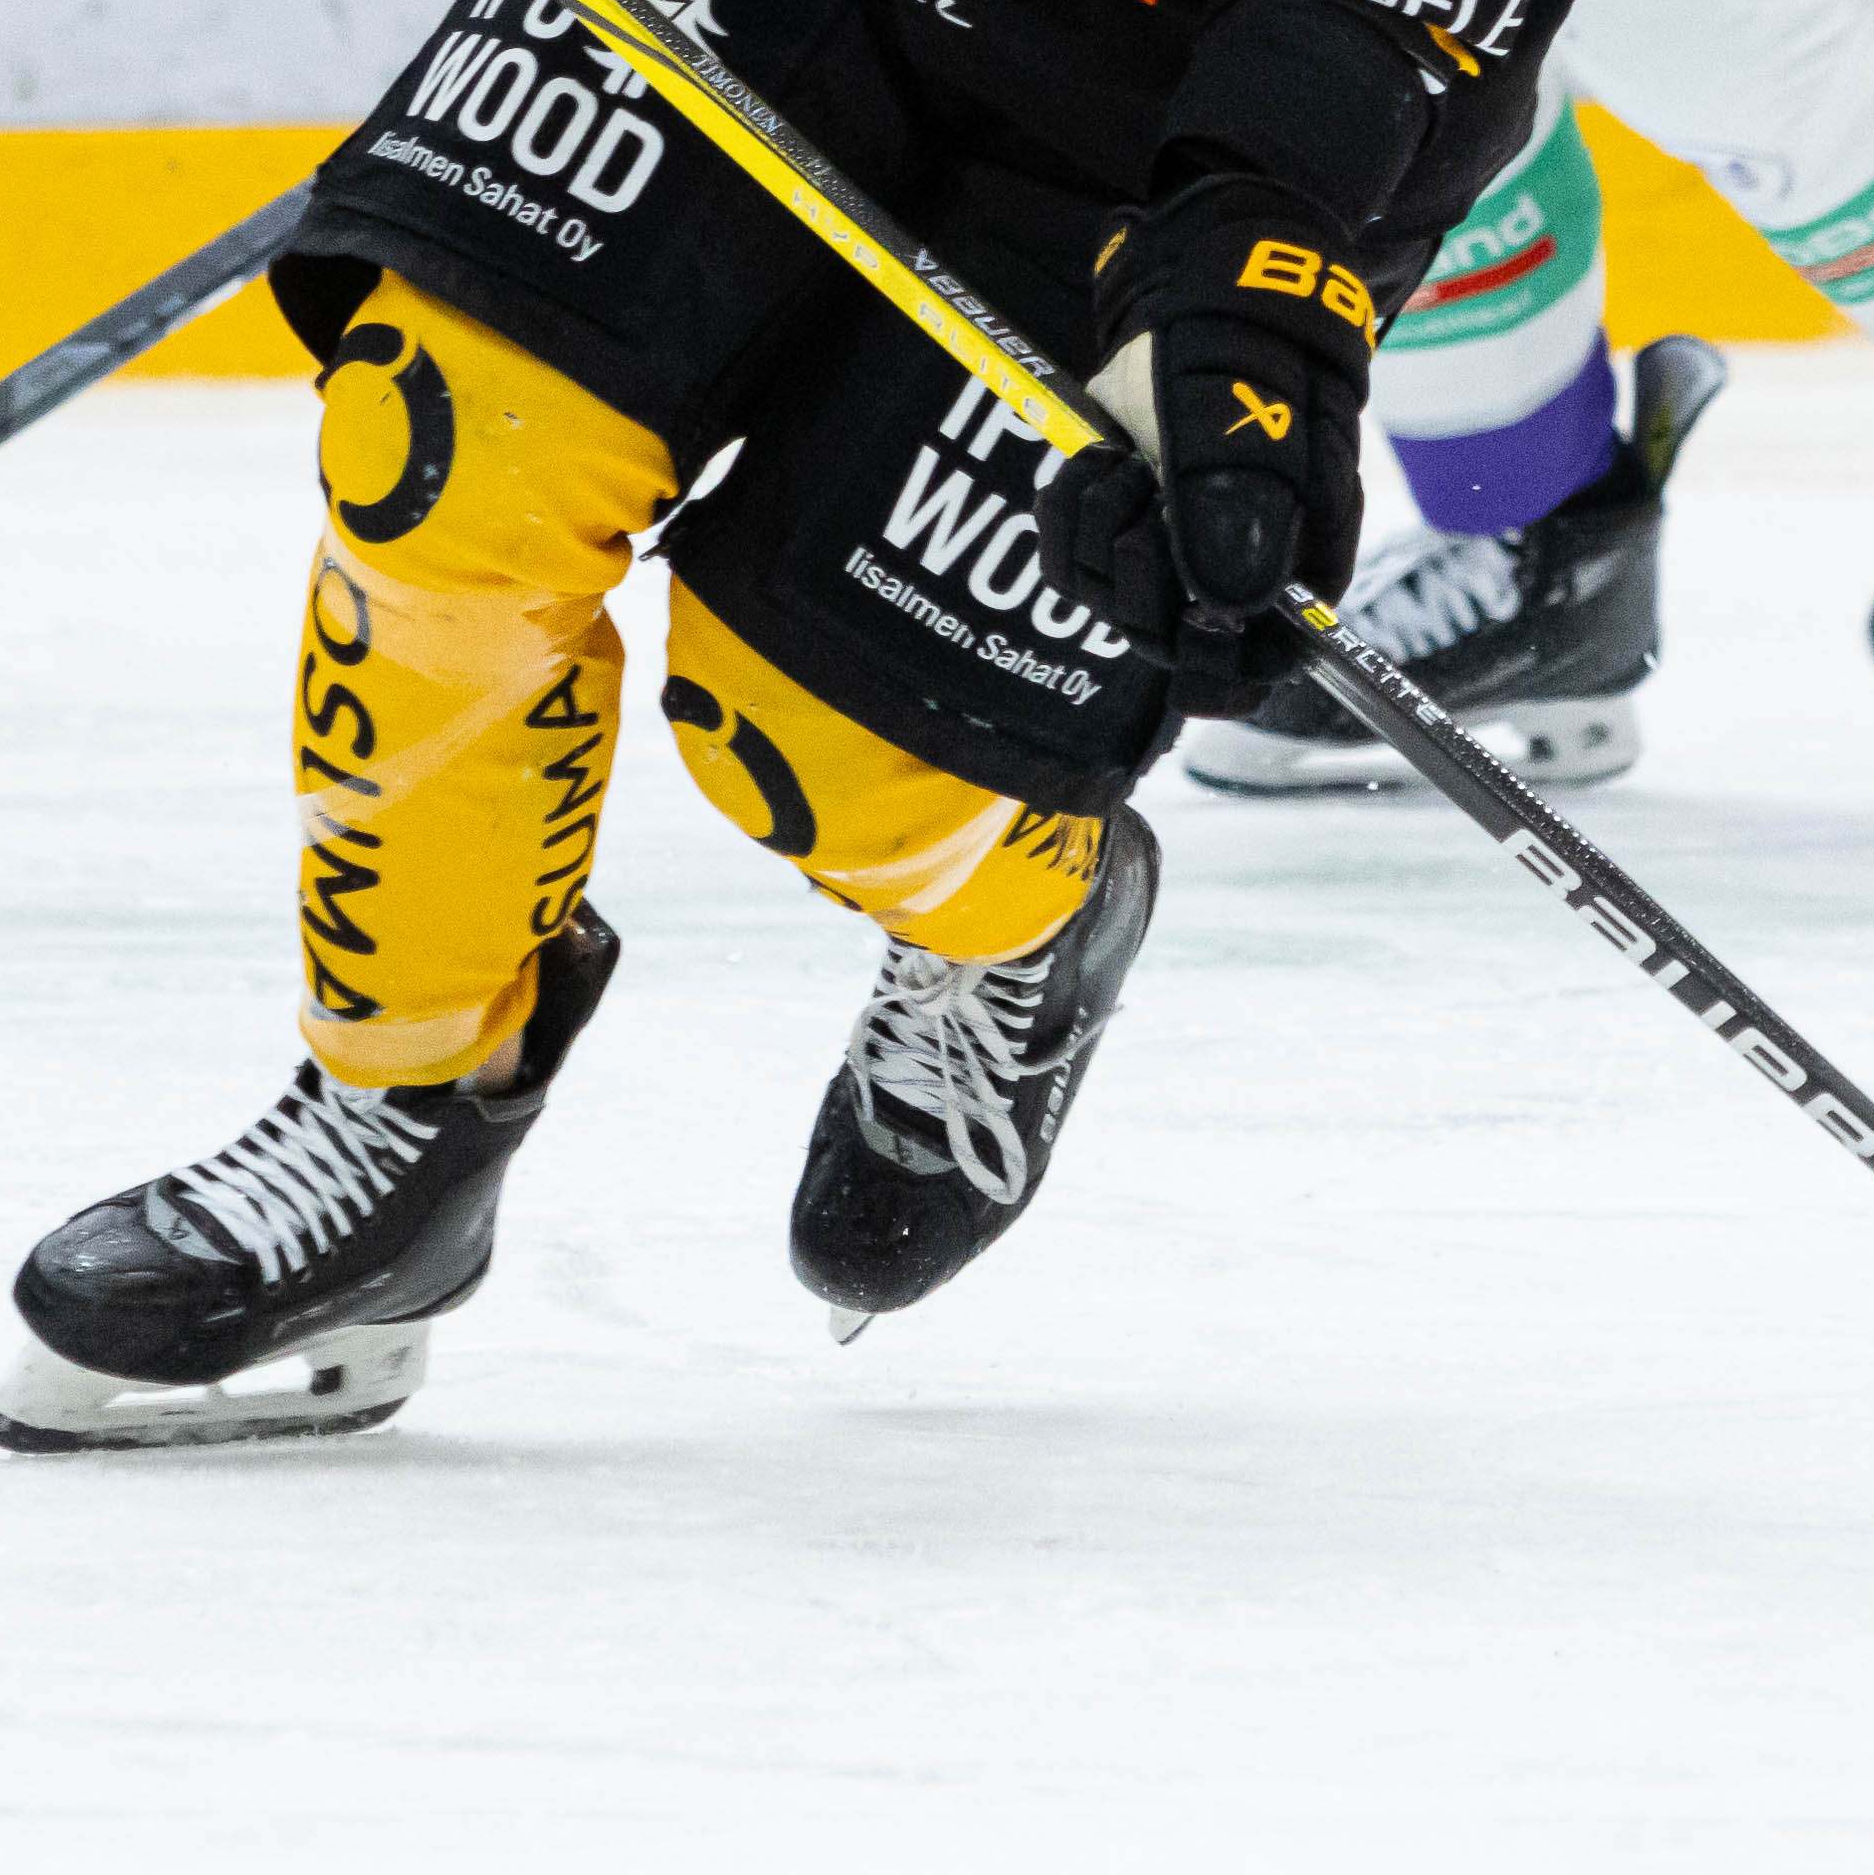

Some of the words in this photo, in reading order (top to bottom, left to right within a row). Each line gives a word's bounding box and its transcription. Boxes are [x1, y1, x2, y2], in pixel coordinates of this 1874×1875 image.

[405, 28, 666, 215] WOOD
[462, 166, 560, 235] Sahat
[555, 218, 605, 262] Oy
[844, 546, 976, 650] Iisalmen
[976, 633, 1067, 690] Sahat
[1060, 668, 1103, 706] Oy
[524, 663, 606, 940] SUMA
